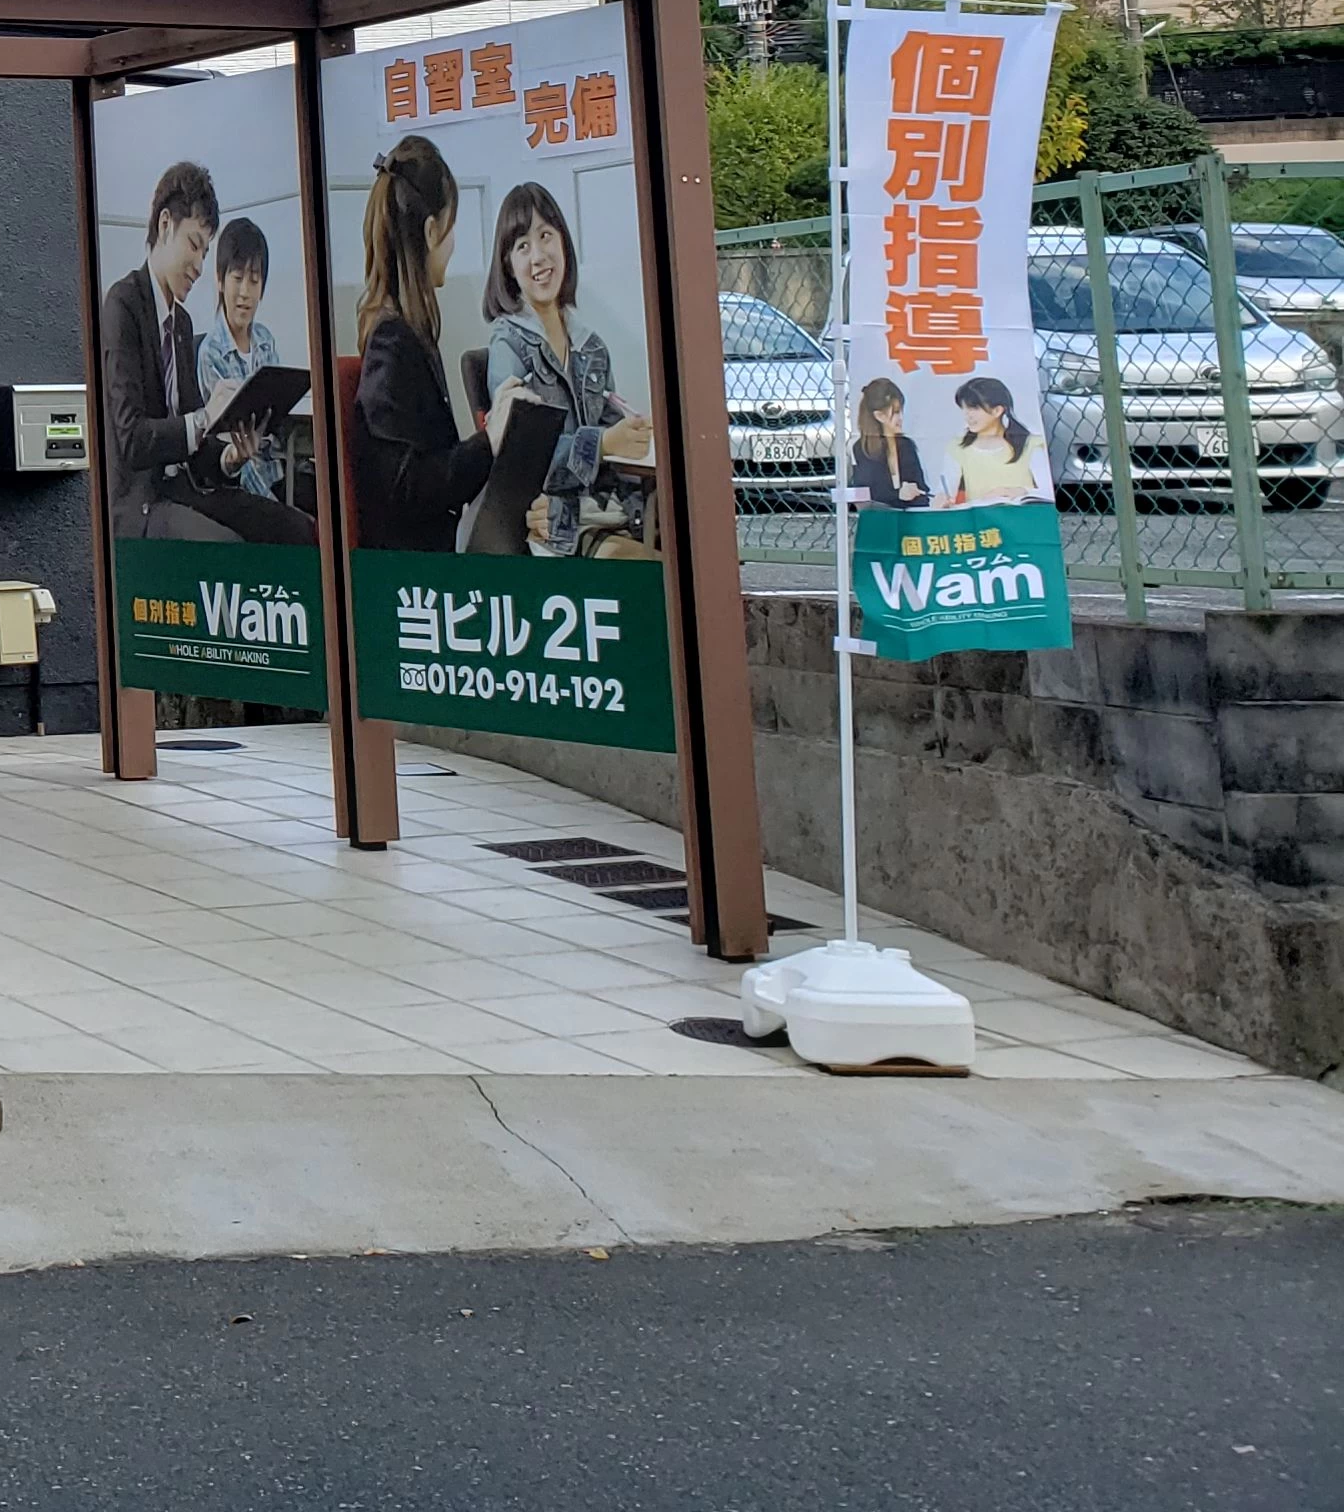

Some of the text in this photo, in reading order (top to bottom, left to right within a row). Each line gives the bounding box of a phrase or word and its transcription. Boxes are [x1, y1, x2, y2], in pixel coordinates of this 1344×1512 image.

[384, 42, 618, 150] 自習室 完備
[882, 30, 1006, 376] 個別指導
[901, 527, 1003, 556] 個別指導
[133, 597, 198, 627] 個別指導
[870, 562, 1045, 612] Wam
[200, 581, 308, 646] Wam
[169, 643, 270, 665] WHOLE ABILITY MAKING
[427, 662, 625, 712] 0120-914-192
